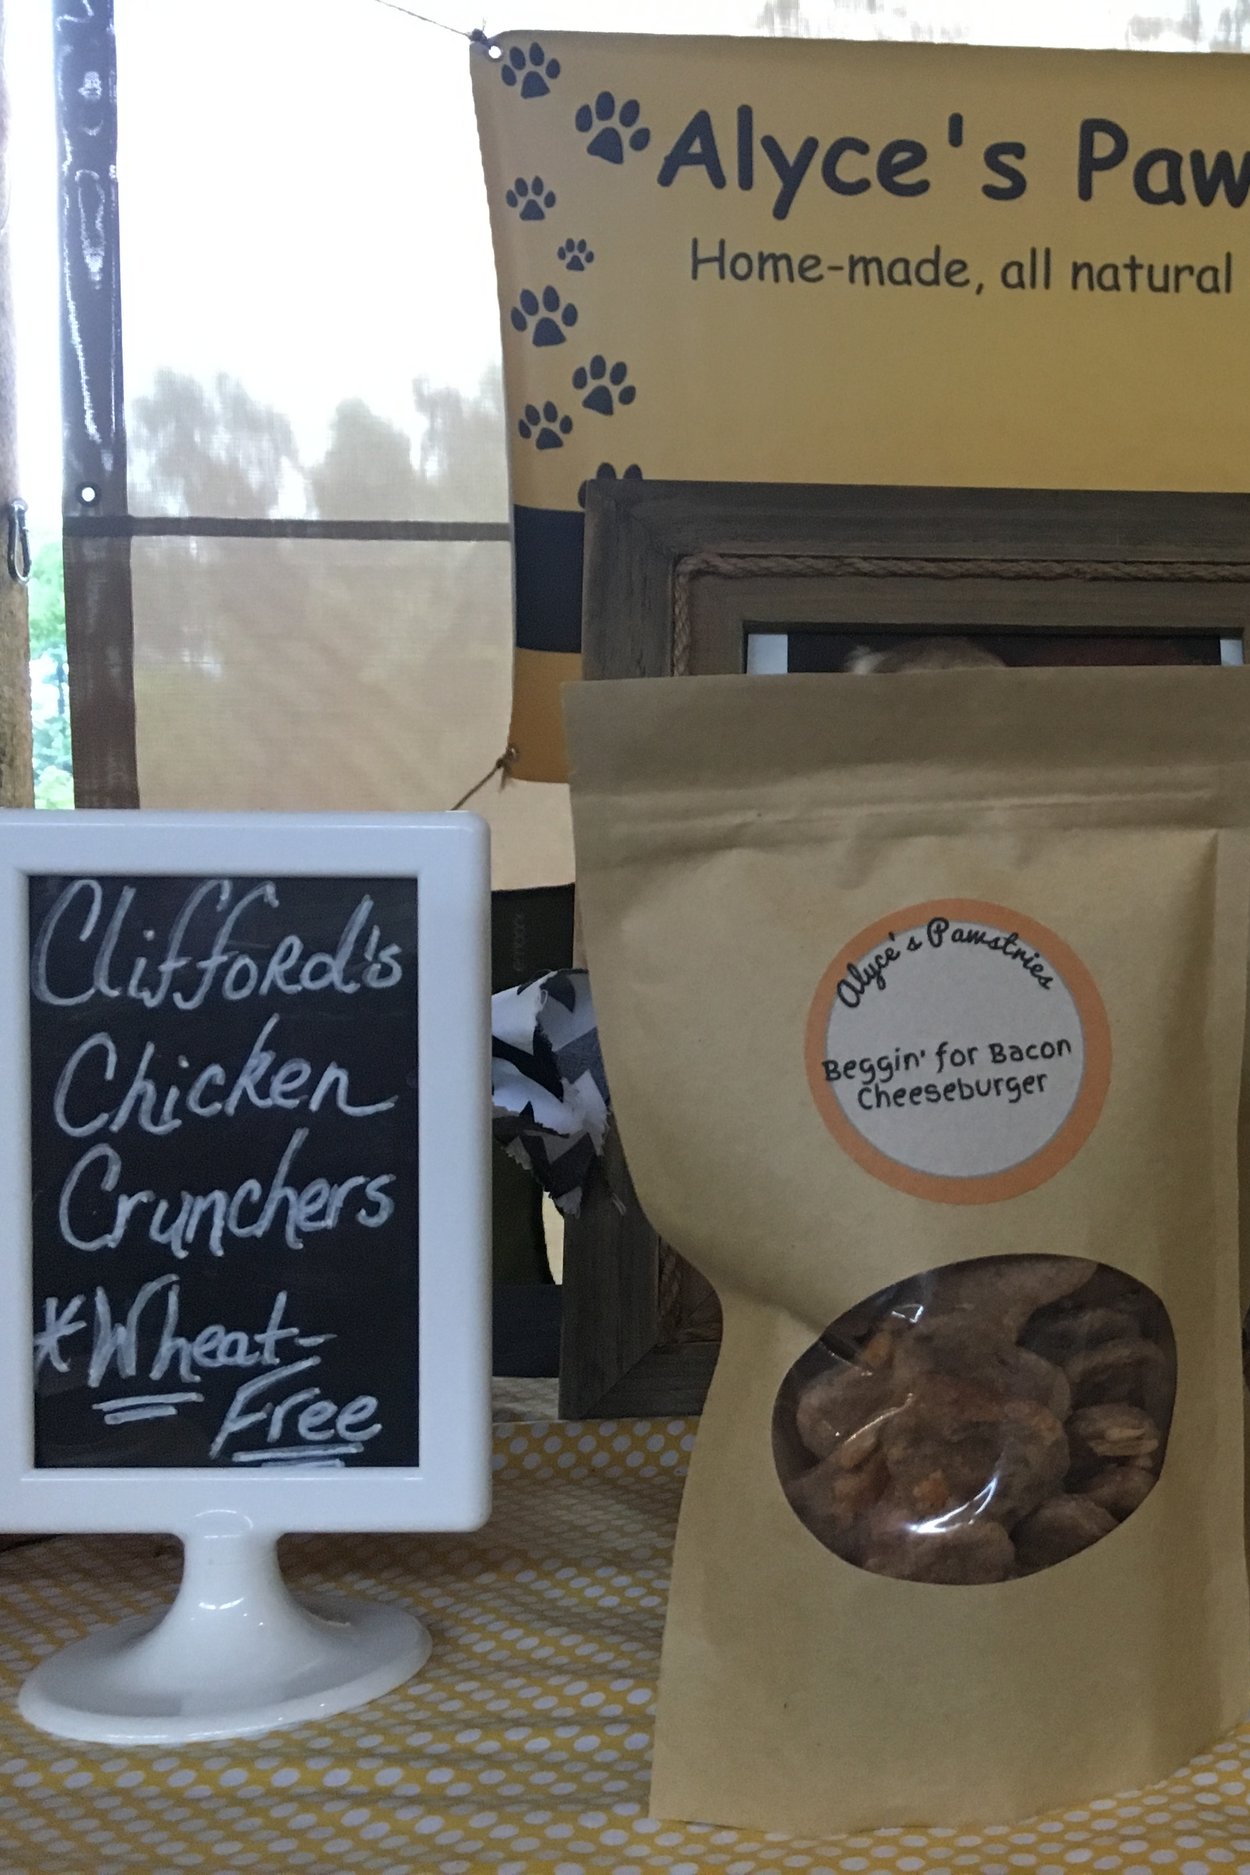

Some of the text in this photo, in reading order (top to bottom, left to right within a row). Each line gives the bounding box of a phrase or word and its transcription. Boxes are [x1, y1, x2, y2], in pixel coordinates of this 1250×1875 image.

[657, 104, 1027, 221] Alyce's
[690, 237, 984, 295] Home-made,
[1001, 246, 1051, 290] all
[1071, 252, 1232, 294] natural
[836, 917, 1054, 1008] Alyce's Pawstries
[54, 1013, 398, 1137] Chicken
[822, 1038, 1072, 1084] Beggin' for Bacon
[857, 1073, 1048, 1110] Cheeseburger
[59, 1127, 396, 1259] Crunchers
[209, 1356, 382, 1459] Free
